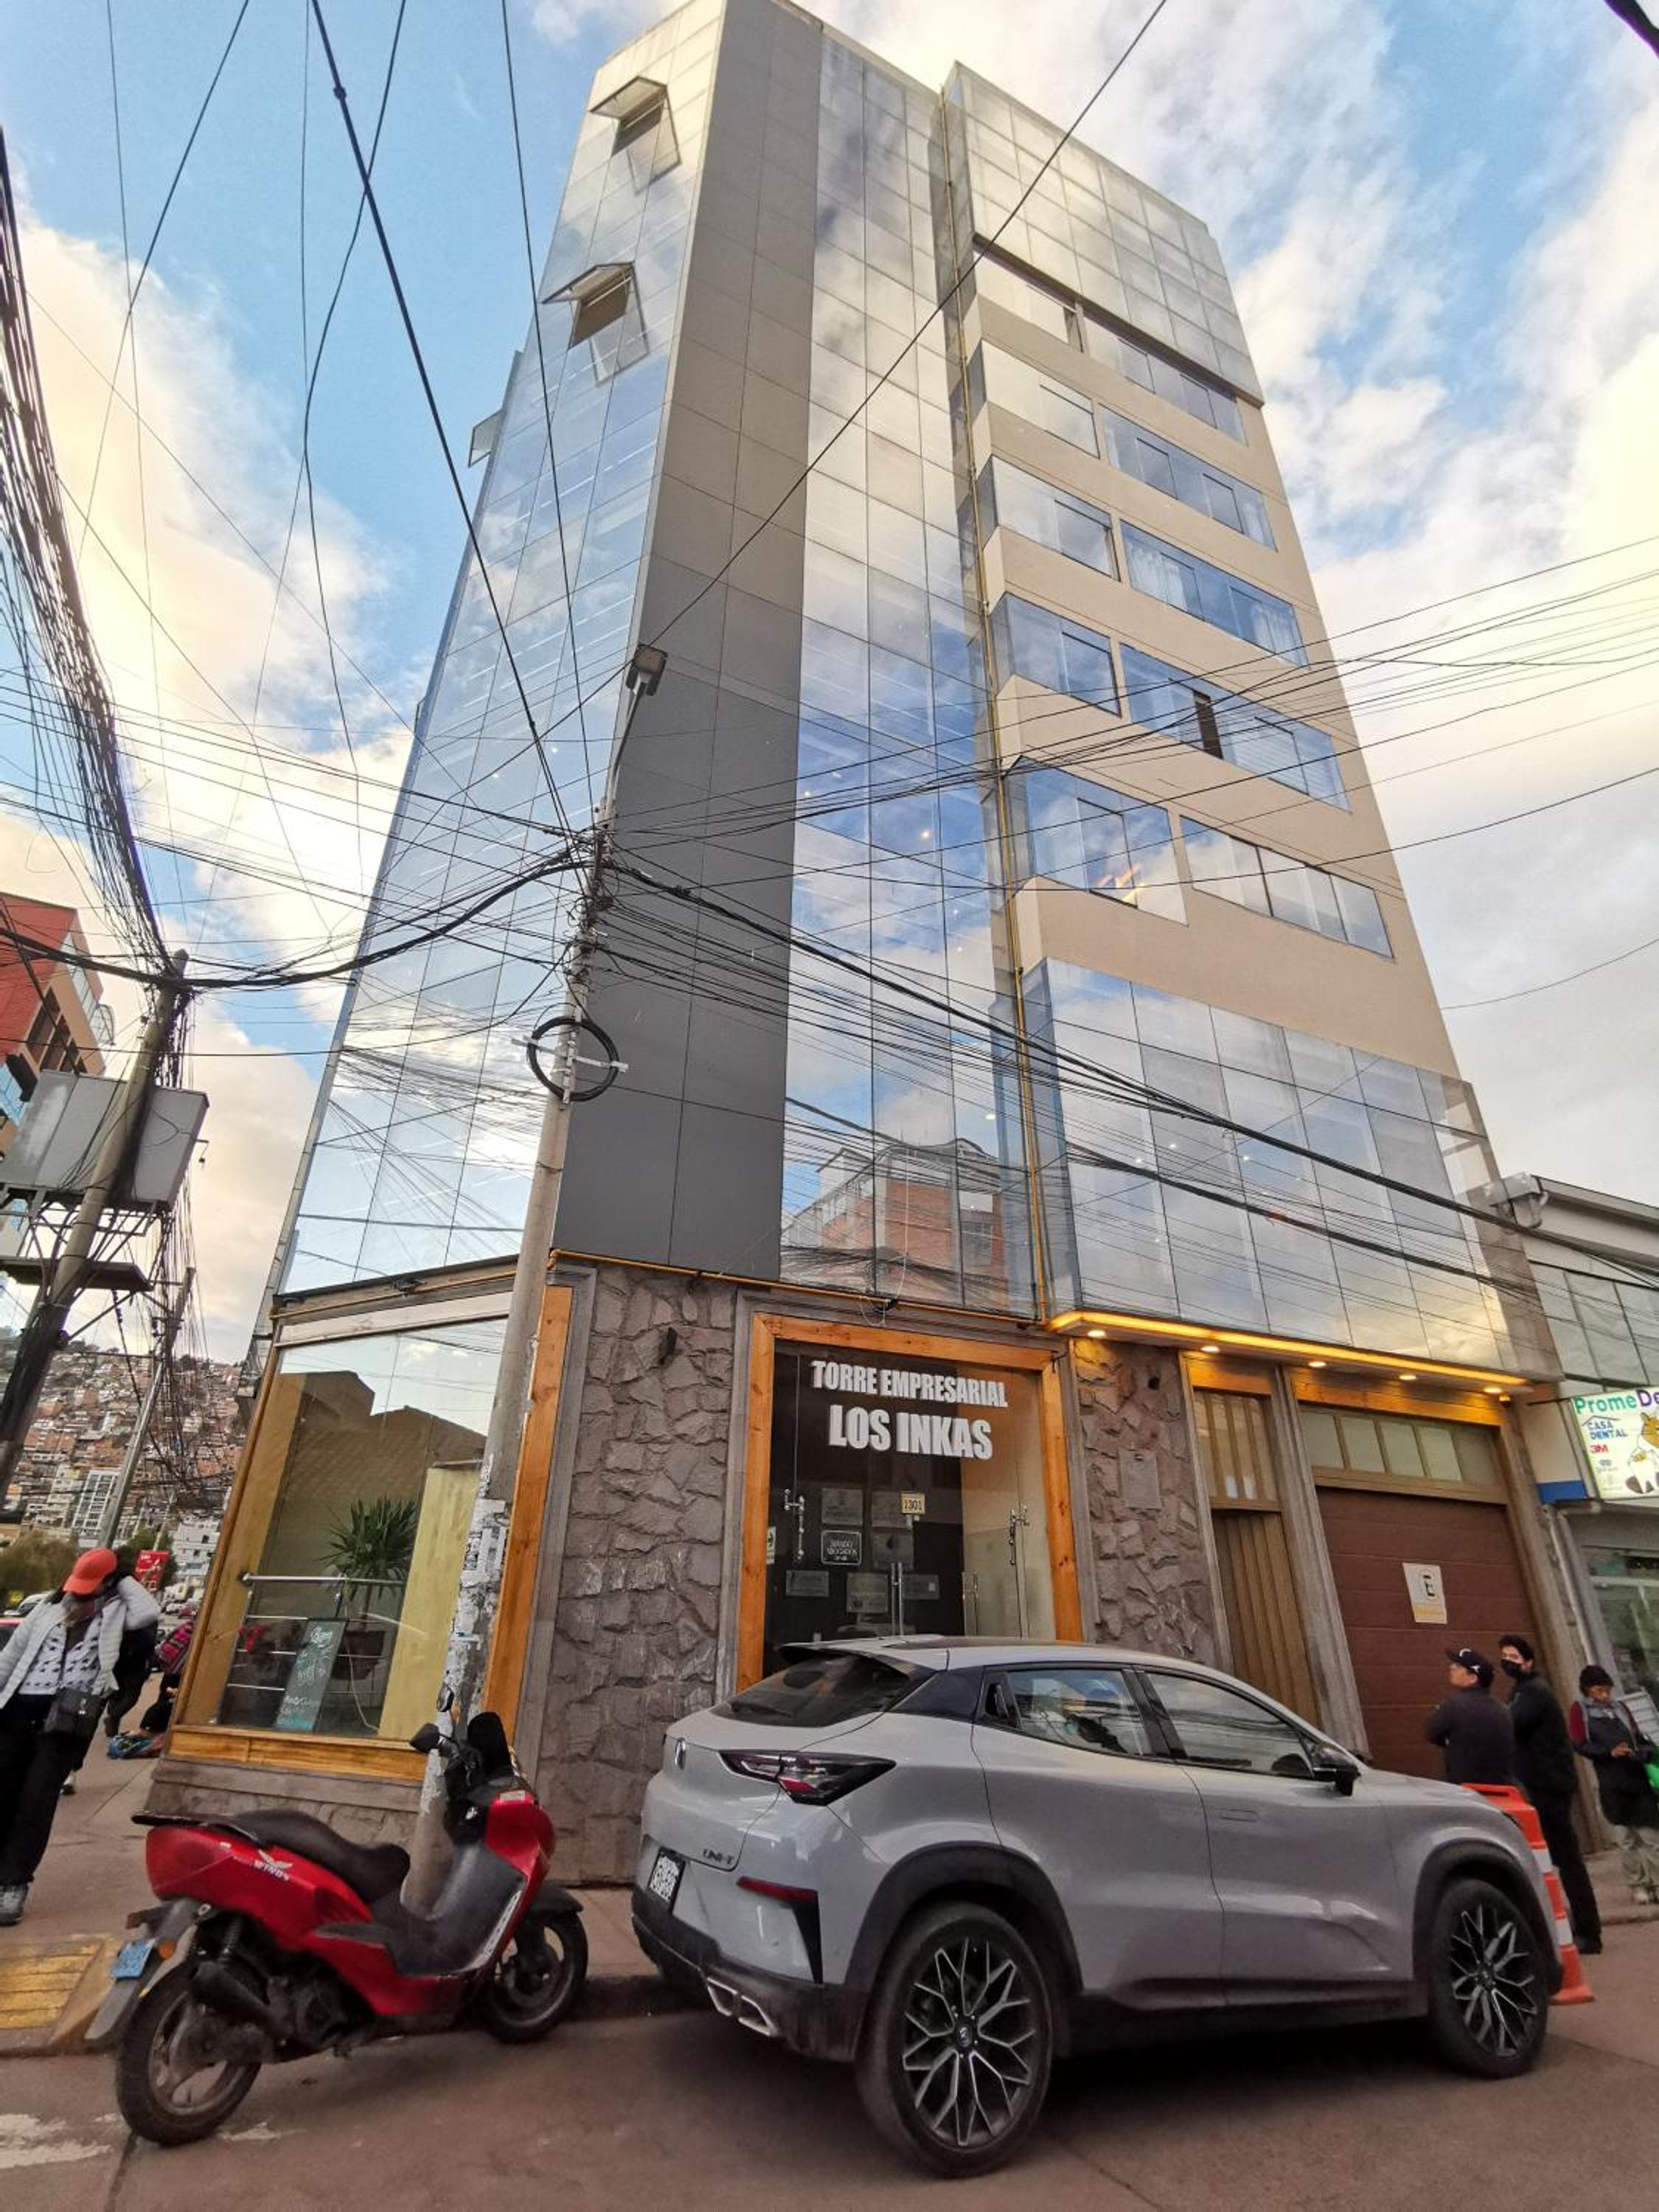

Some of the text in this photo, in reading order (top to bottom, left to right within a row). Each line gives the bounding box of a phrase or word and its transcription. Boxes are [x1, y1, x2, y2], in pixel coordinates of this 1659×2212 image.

[811, 1360, 1008, 1407] TORRE EMPRESARIAL
[1587, 1420, 1613, 1430] CASA
[828, 1405, 992, 1459] LOS INKAS
[1590, 1429, 1627, 1440] DENTAL
[1590, 1444, 1608, 1453] 3M
[903, 1498, 923, 1512] 1301
